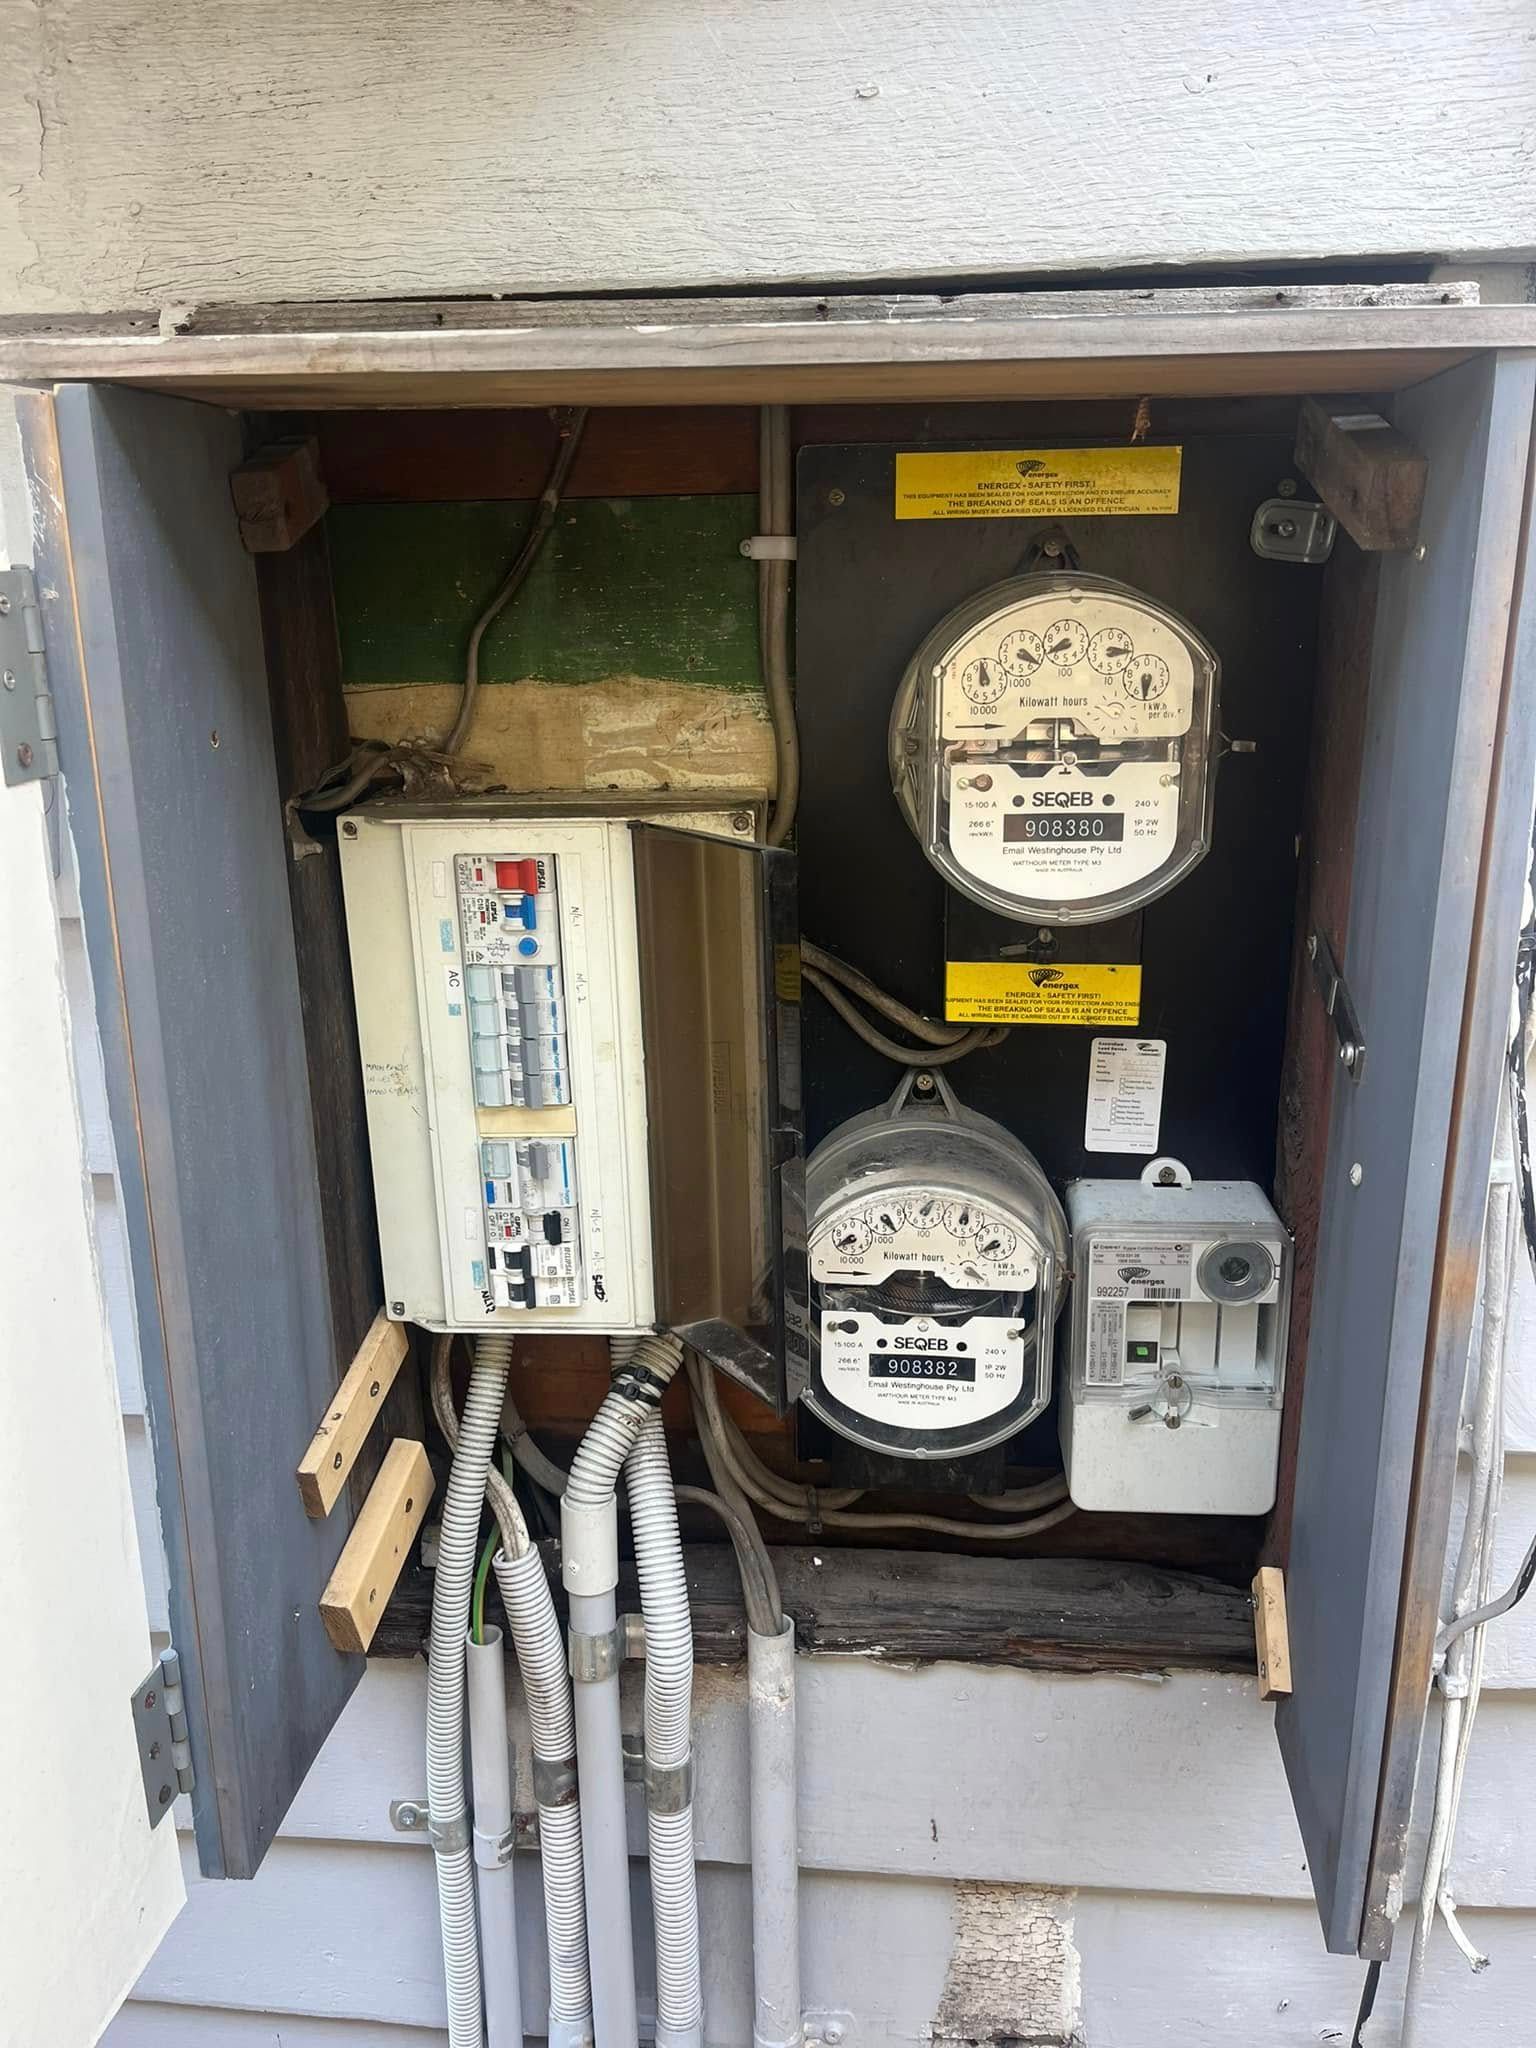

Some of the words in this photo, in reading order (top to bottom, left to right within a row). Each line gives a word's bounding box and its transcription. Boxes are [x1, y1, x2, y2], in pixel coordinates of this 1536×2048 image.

[1027, 481, 1062, 489] SAFETY
[966, 499, 1011, 507] BREAKING
[1057, 668, 1072, 677] 100
[1008, 678, 1031, 687] 1000
[1103, 676, 1113, 685] 10
[1019, 696, 1058, 707] Kilowatt
[1062, 696, 1088, 707] hours
[1031, 791, 1093, 808] SEQEB
[1134, 799, 1150, 807] 240
[1025, 819, 1104, 837] 908380
[1133, 828, 1144, 836] 50
[1146, 828, 1157, 836] Hz
[1002, 846, 1024, 854] Email
[1027, 846, 1086, 856] Westinghouse
[1090, 846, 1104, 856] Pty
[1107, 846, 1121, 854] Ltd
[537, 860, 547, 890] CLIPSAL
[490, 901, 498, 923] CLIPSAL
[448, 970, 460, 988] AC
[993, 1005, 1032, 1013] BREAKING
[1045, 1006, 1070, 1014] SEALS
[917, 1229, 930, 1237] 100
[874, 1236, 893, 1244] 1000
[883, 1250, 917, 1260] Kilowatt
[921, 1252, 944, 1261] hours
[1096, 1286, 1129, 1298] 992257
[894, 1336, 947, 1351] SEQEB
[984, 1347, 999, 1355] 240
[888, 1358, 957, 1377] 908382
[867, 1380, 888, 1388] Email
[890, 1381, 943, 1391] Westinghouse
[946, 1383, 959, 1392] Pty
[961, 1384, 974, 1393] Ltd
